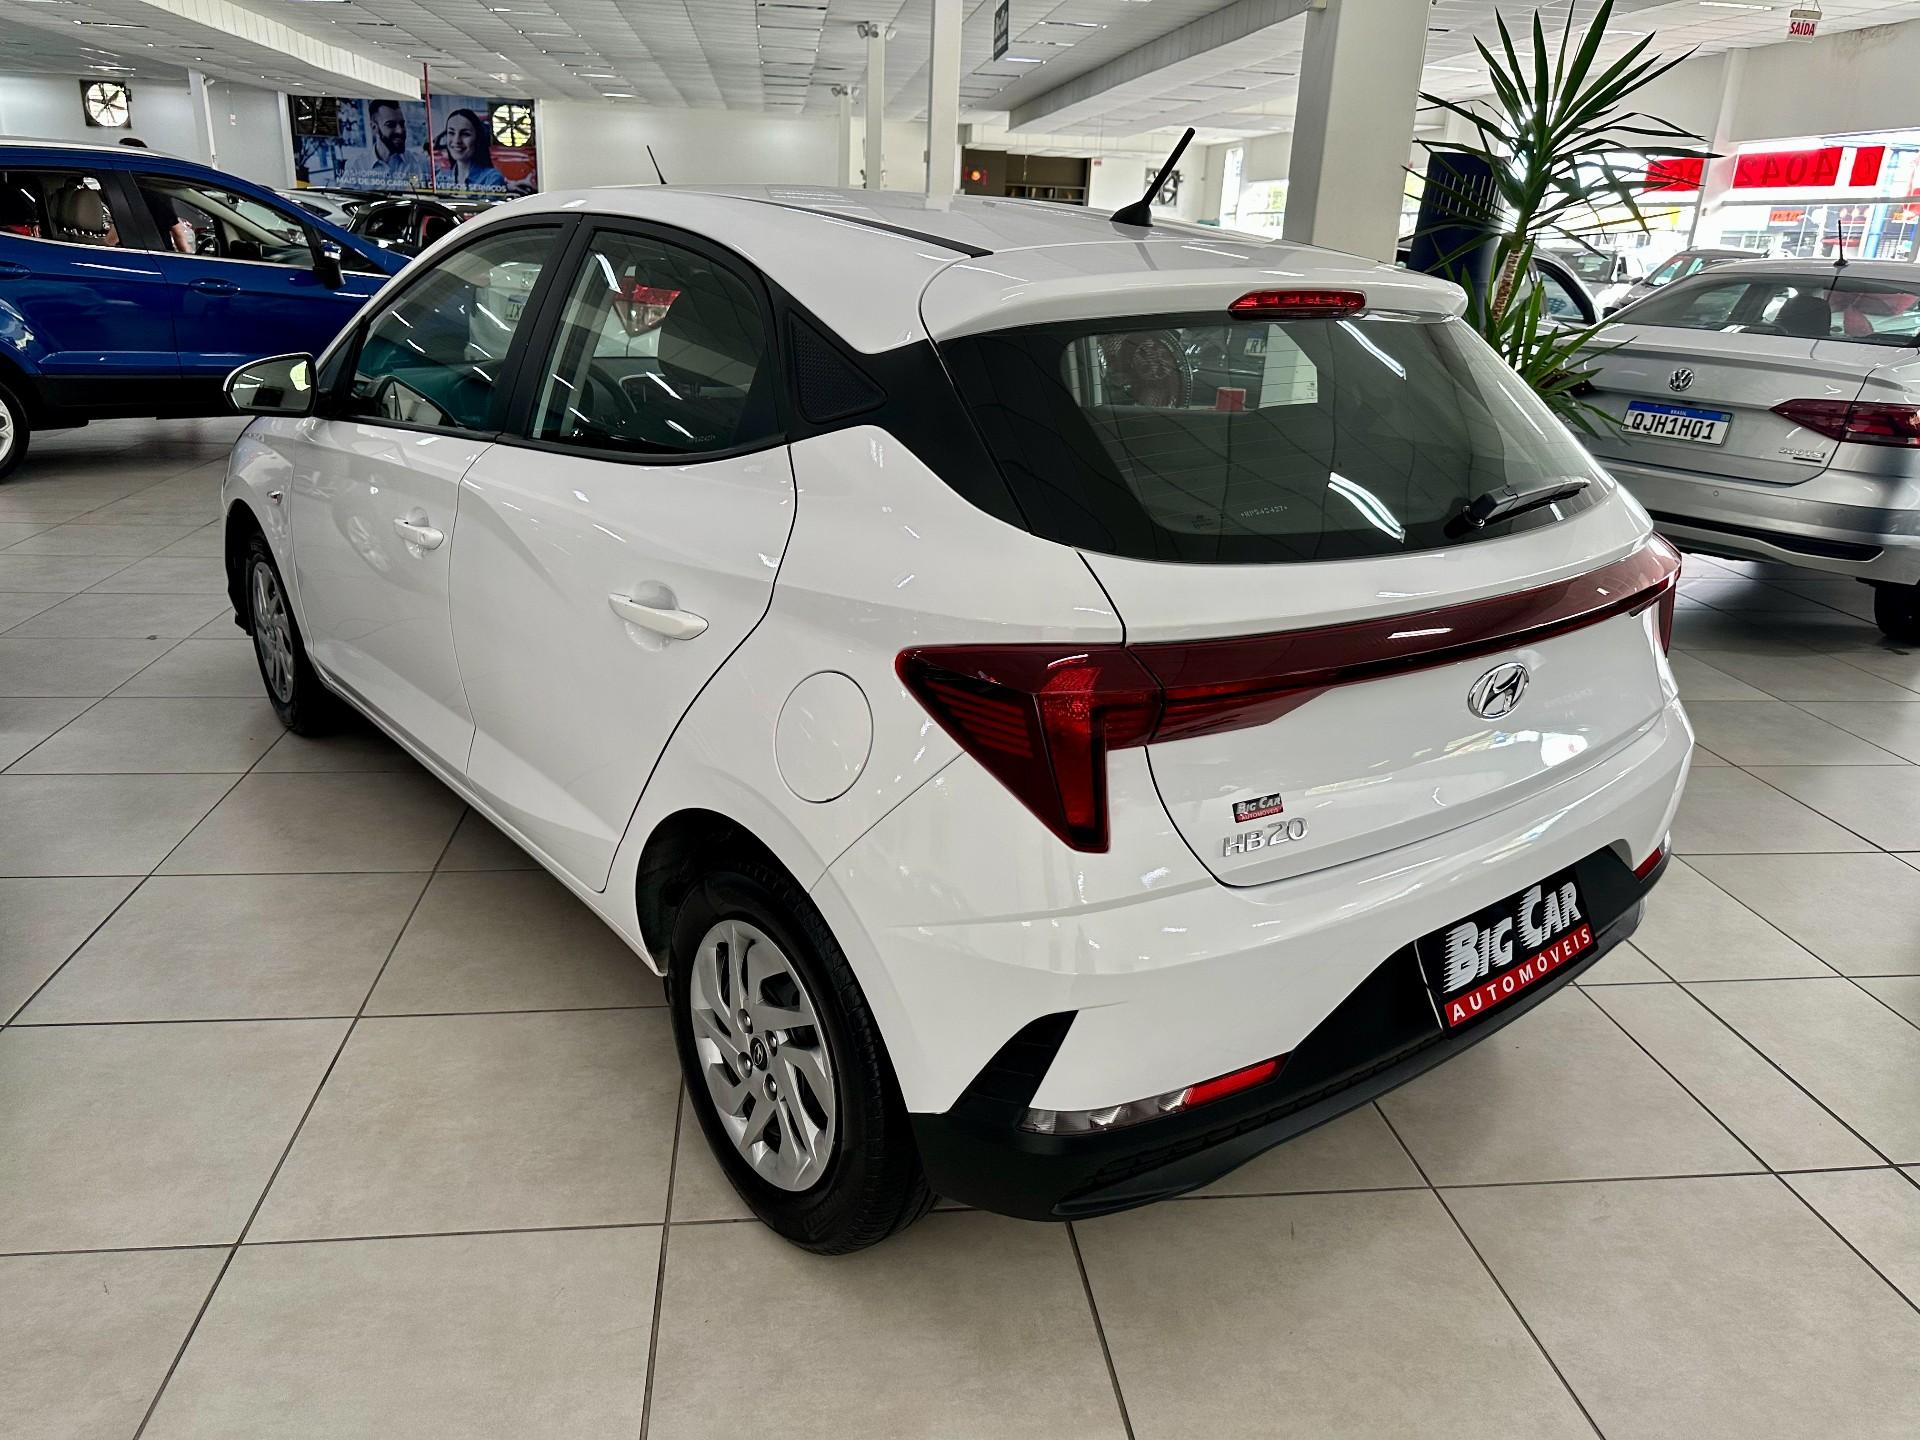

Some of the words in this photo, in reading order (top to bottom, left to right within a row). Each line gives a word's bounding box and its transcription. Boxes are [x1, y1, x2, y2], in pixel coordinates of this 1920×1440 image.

[1790, 20, 1815, 36] SAÍDA
[336, 177, 356, 185] MAIS
[387, 179, 420, 188] CARRS
[428, 181, 466, 191] DVERSOS
[1631, 413, 1716, 440] QJH1H01
[1236, 802, 1256, 815] BIG
[1259, 796, 1281, 809] CAR
[1222, 817, 1309, 857] HB20
[1443, 917, 1513, 994] BIG
[1517, 881, 1582, 950] CAR
[1453, 928, 1590, 1022] AUTOMÓVEIS
